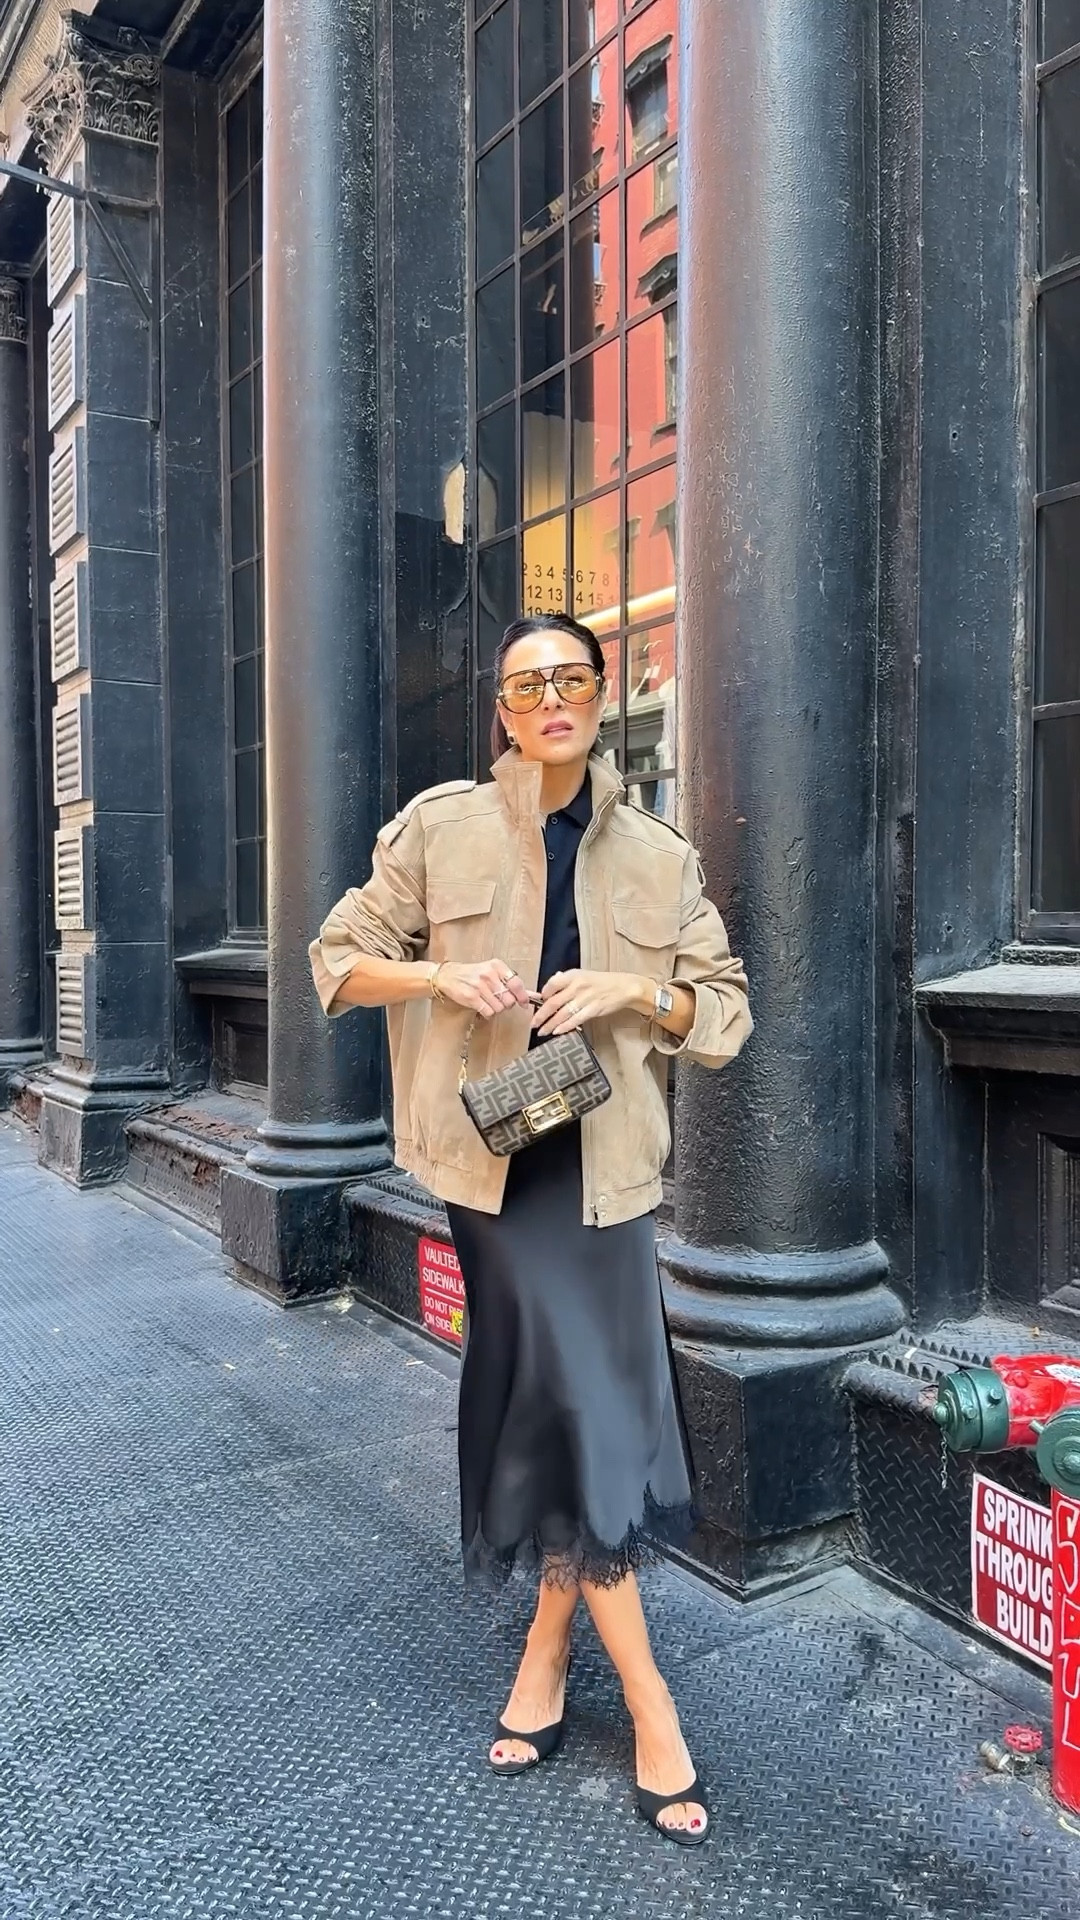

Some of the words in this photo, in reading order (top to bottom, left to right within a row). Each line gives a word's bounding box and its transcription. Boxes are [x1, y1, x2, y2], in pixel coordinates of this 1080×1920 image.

[535, 565, 542, 578] 3
[546, 566, 554, 579] 4
[576, 570, 583, 583] 6
[589, 571, 596, 584] 7
[602, 573, 609, 586] 8
[527, 585, 542, 599] 12
[548, 587, 563, 602] 13
[424, 1245, 461, 1271] VAULTED
[422, 1266, 466, 1296] SIDEWALK
[424, 1295, 434, 1309] DO
[434, 1299, 448, 1315] NOT
[424, 1311, 435, 1326] ON
[983, 1488, 1053, 1562] SPRINK
[976, 1530, 1053, 1611] THROUG
[996, 1587, 1054, 1657] BUILD
